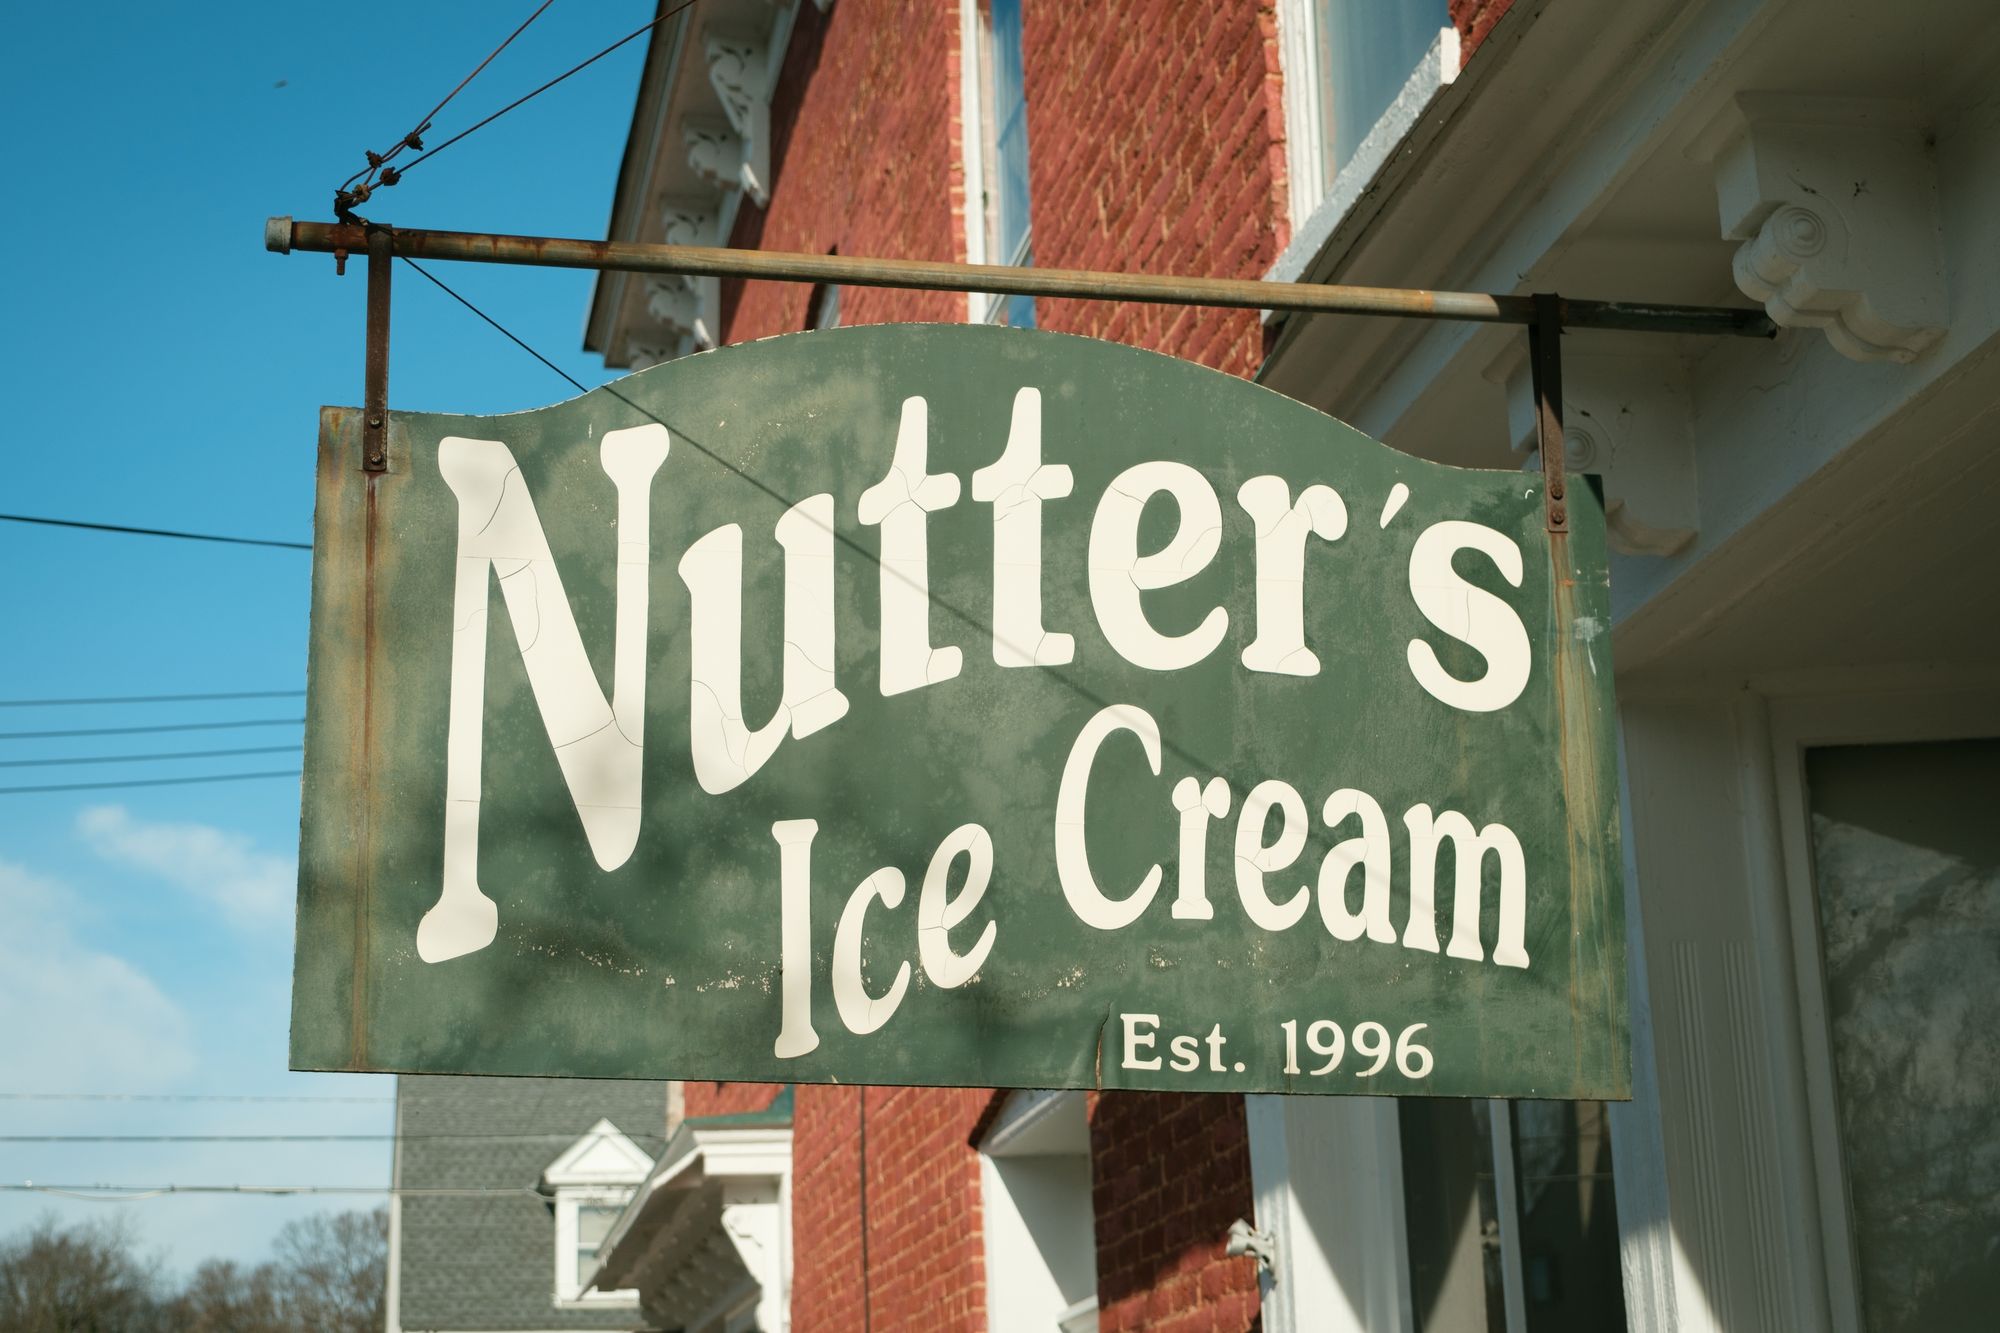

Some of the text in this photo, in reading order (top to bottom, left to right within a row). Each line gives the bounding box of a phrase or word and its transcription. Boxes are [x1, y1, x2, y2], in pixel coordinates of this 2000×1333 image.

[416, 386, 1533, 964] Nutter's
[771, 703, 1531, 1059] Ice Cream
[1119, 1012, 1434, 1080] Est. 1996
